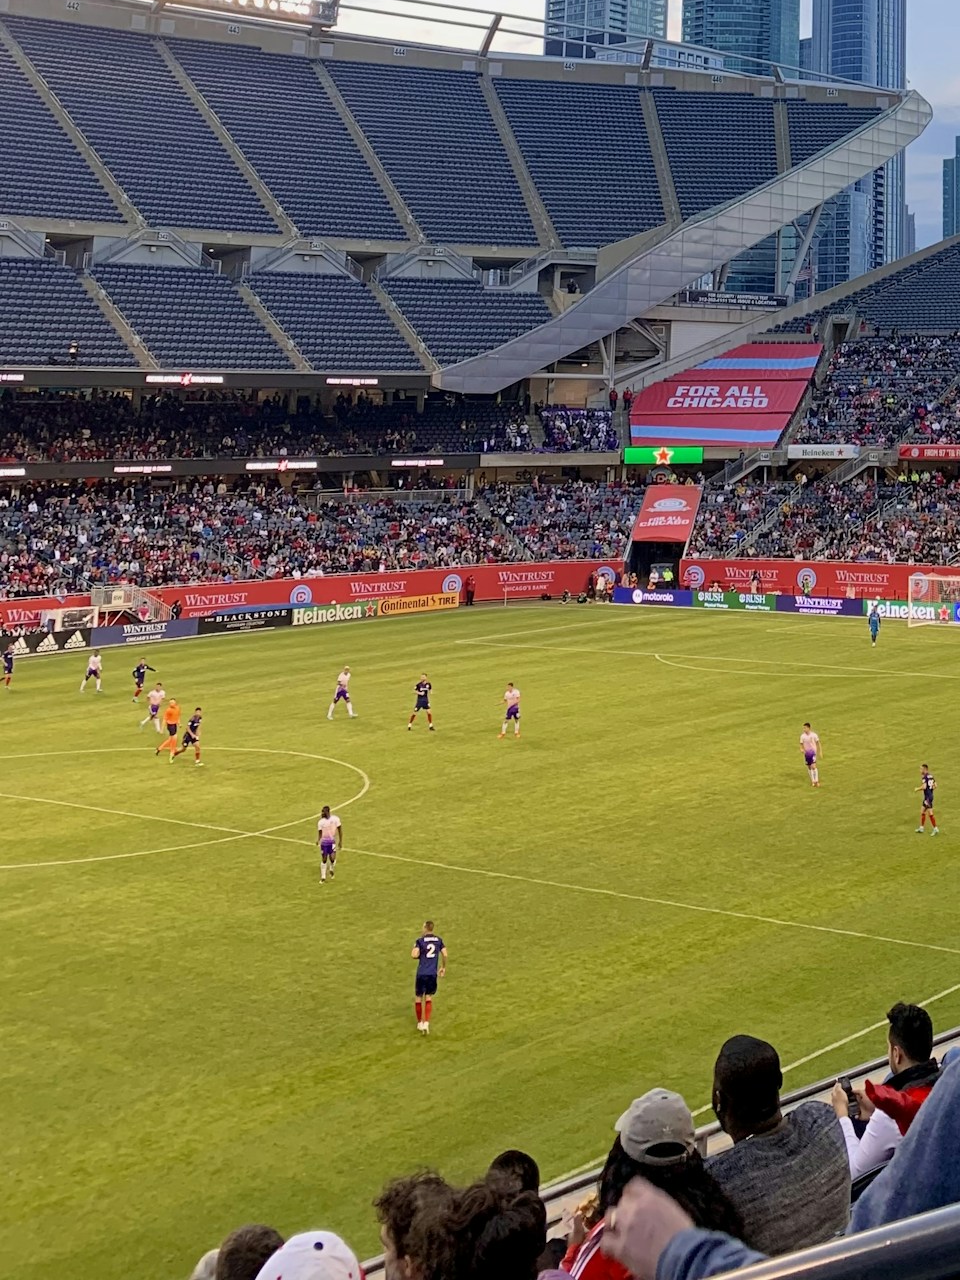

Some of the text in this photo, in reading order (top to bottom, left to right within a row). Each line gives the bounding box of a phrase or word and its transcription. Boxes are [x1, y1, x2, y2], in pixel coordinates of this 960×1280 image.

[675, 386, 766, 397] FOR ALL
[666, 397, 769, 408] CHICAGO
[802, 448, 834, 456] Heineken
[498, 571, 554, 582] WINTRUST
[836, 570, 889, 583] WINTRUST
[350, 581, 406, 594] WINTRUST
[185, 592, 248, 606] WINTRUST
[642, 592, 674, 602] motorola
[704, 592, 724, 602] RUSH
[746, 594, 766, 604] RUSH
[795, 596, 842, 607] WINTRUST
[380, 598, 428, 614] Continental
[438, 596, 456, 606] TIRE
[866, 600, 936, 620] Heineken
[216, 610, 288, 622] BLACKSTONE
[292, 604, 362, 626] Heineken
[123, 622, 168, 634] WINTRUST
[36, 644, 58, 652] adidas
[64, 640, 86, 648] adidas
[426, 944, 436, 958] 2
